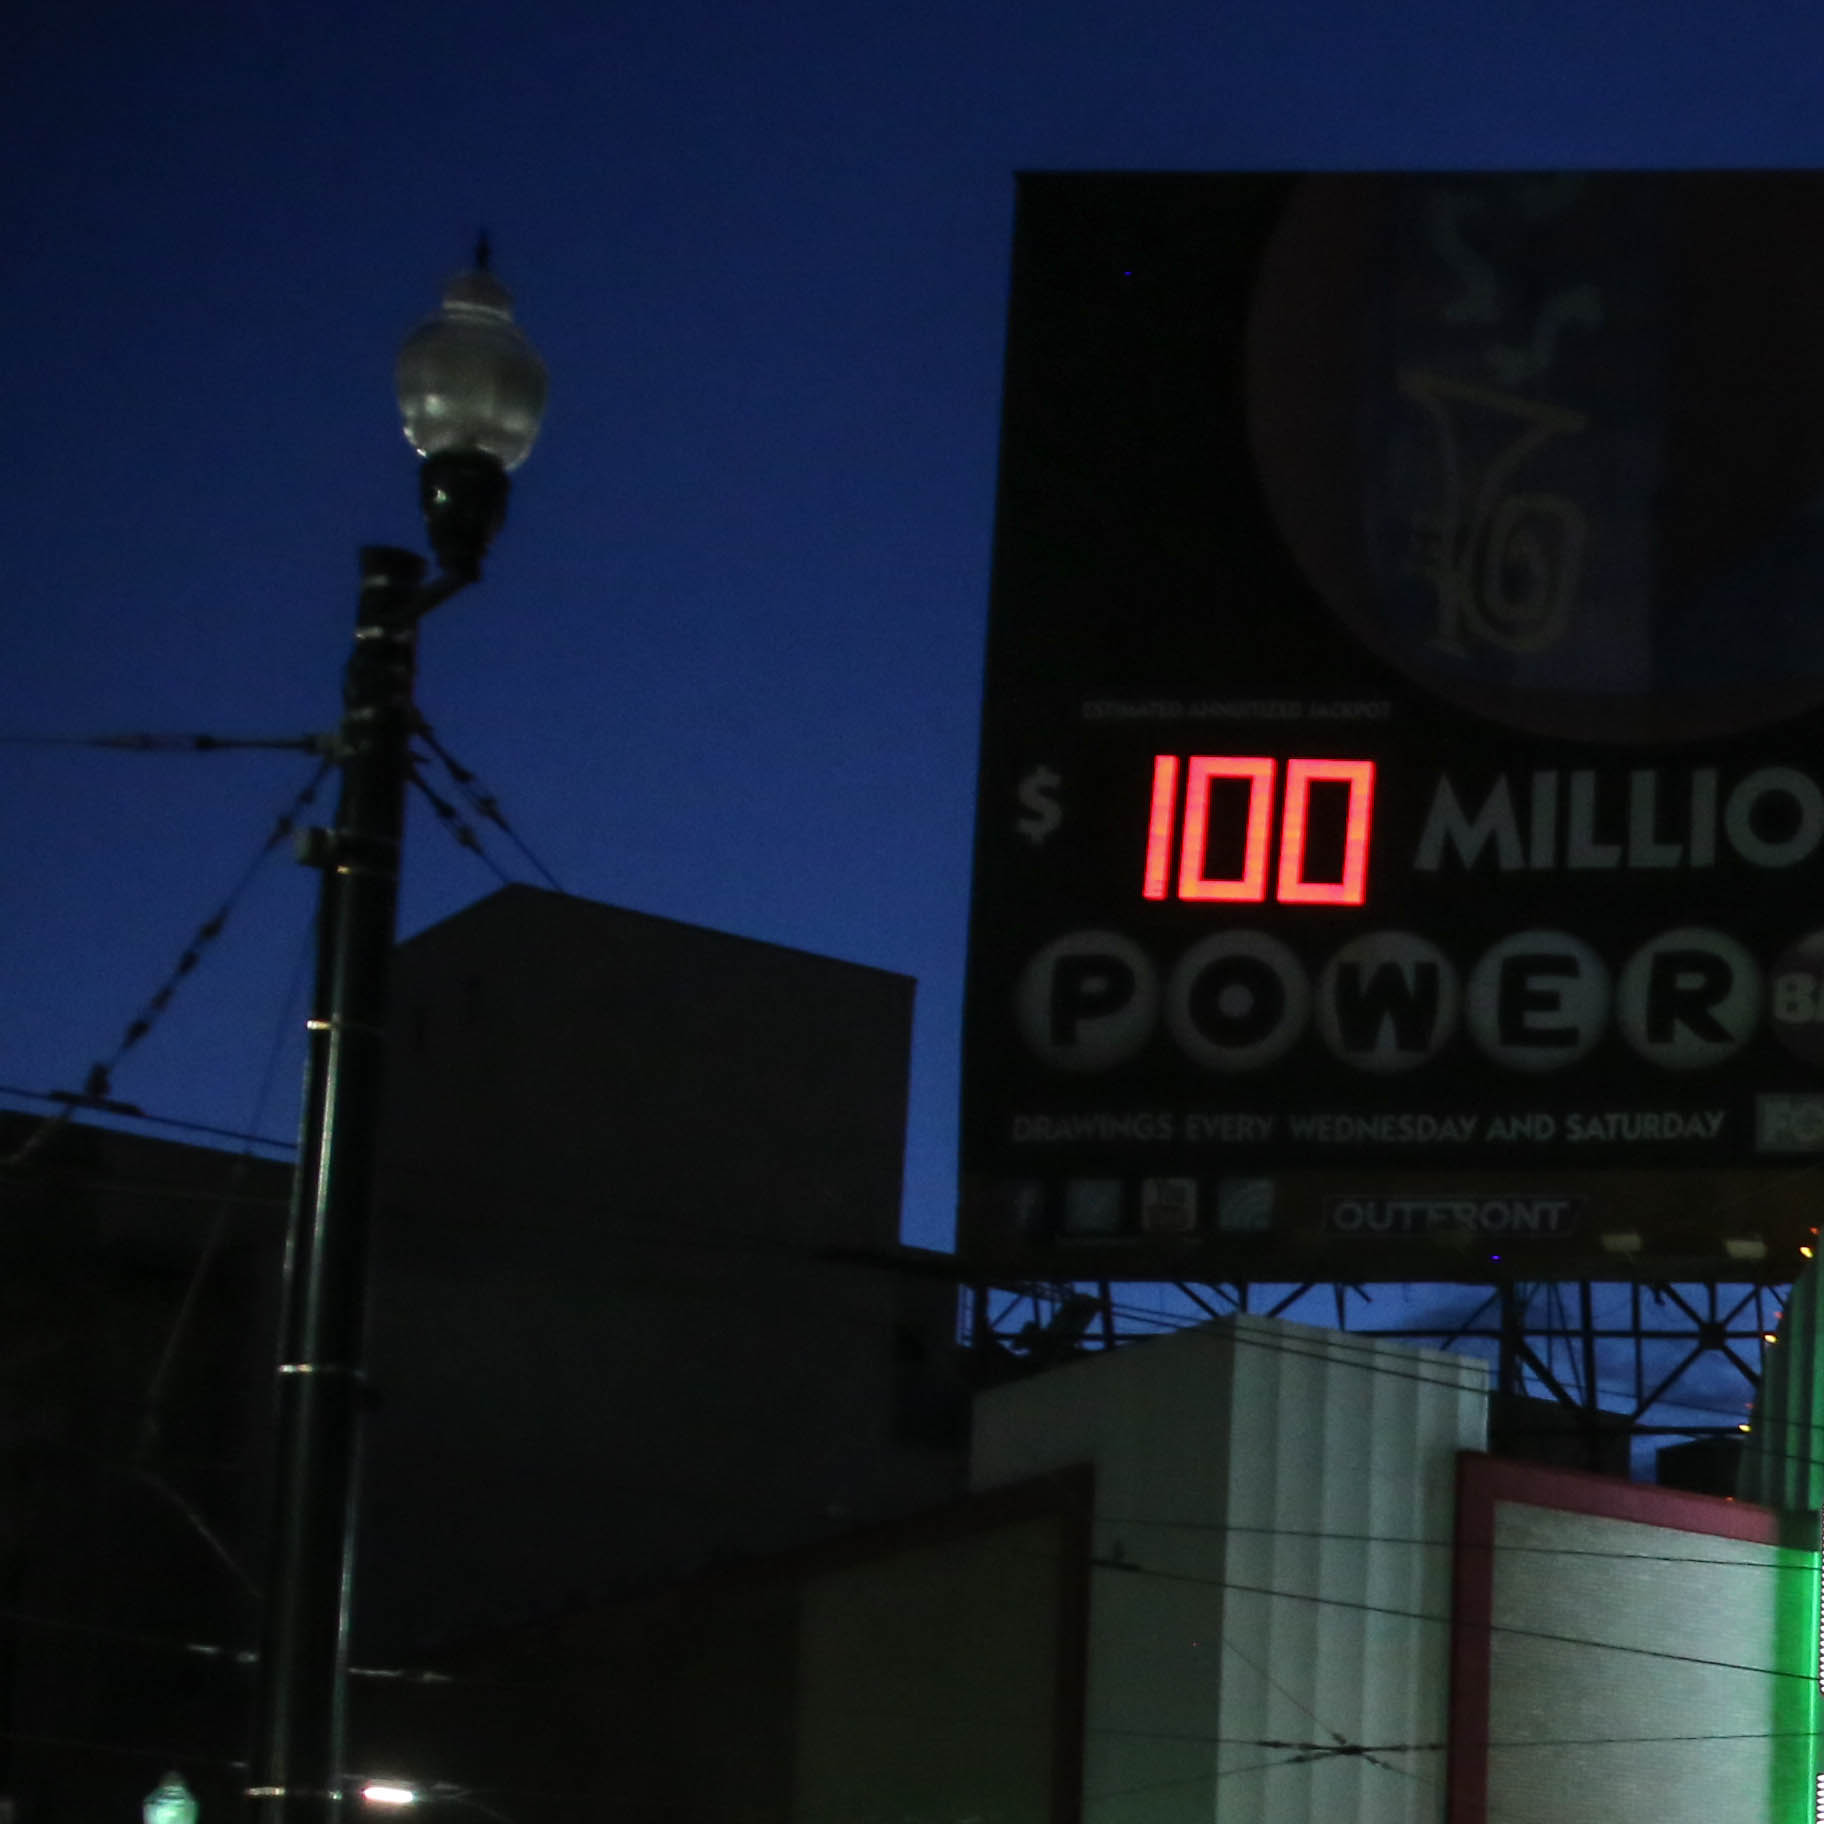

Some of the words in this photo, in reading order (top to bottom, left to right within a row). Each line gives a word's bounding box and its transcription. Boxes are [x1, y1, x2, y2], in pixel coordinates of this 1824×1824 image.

[1017, 763, 1063, 845] $
[1140, 754, 1376, 907] 100
[1045, 945, 1737, 1056] POWER
[1010, 1111, 1175, 1143] DRAWINGS
[1185, 1110, 1274, 1141] EVERY
[1289, 1111, 1478, 1143] WEDNESDAY
[1484, 1111, 1557, 1142] AND
[1565, 1108, 1726, 1142] SATURDAY
[1332, 1198, 1572, 1234] OUTFRONT
